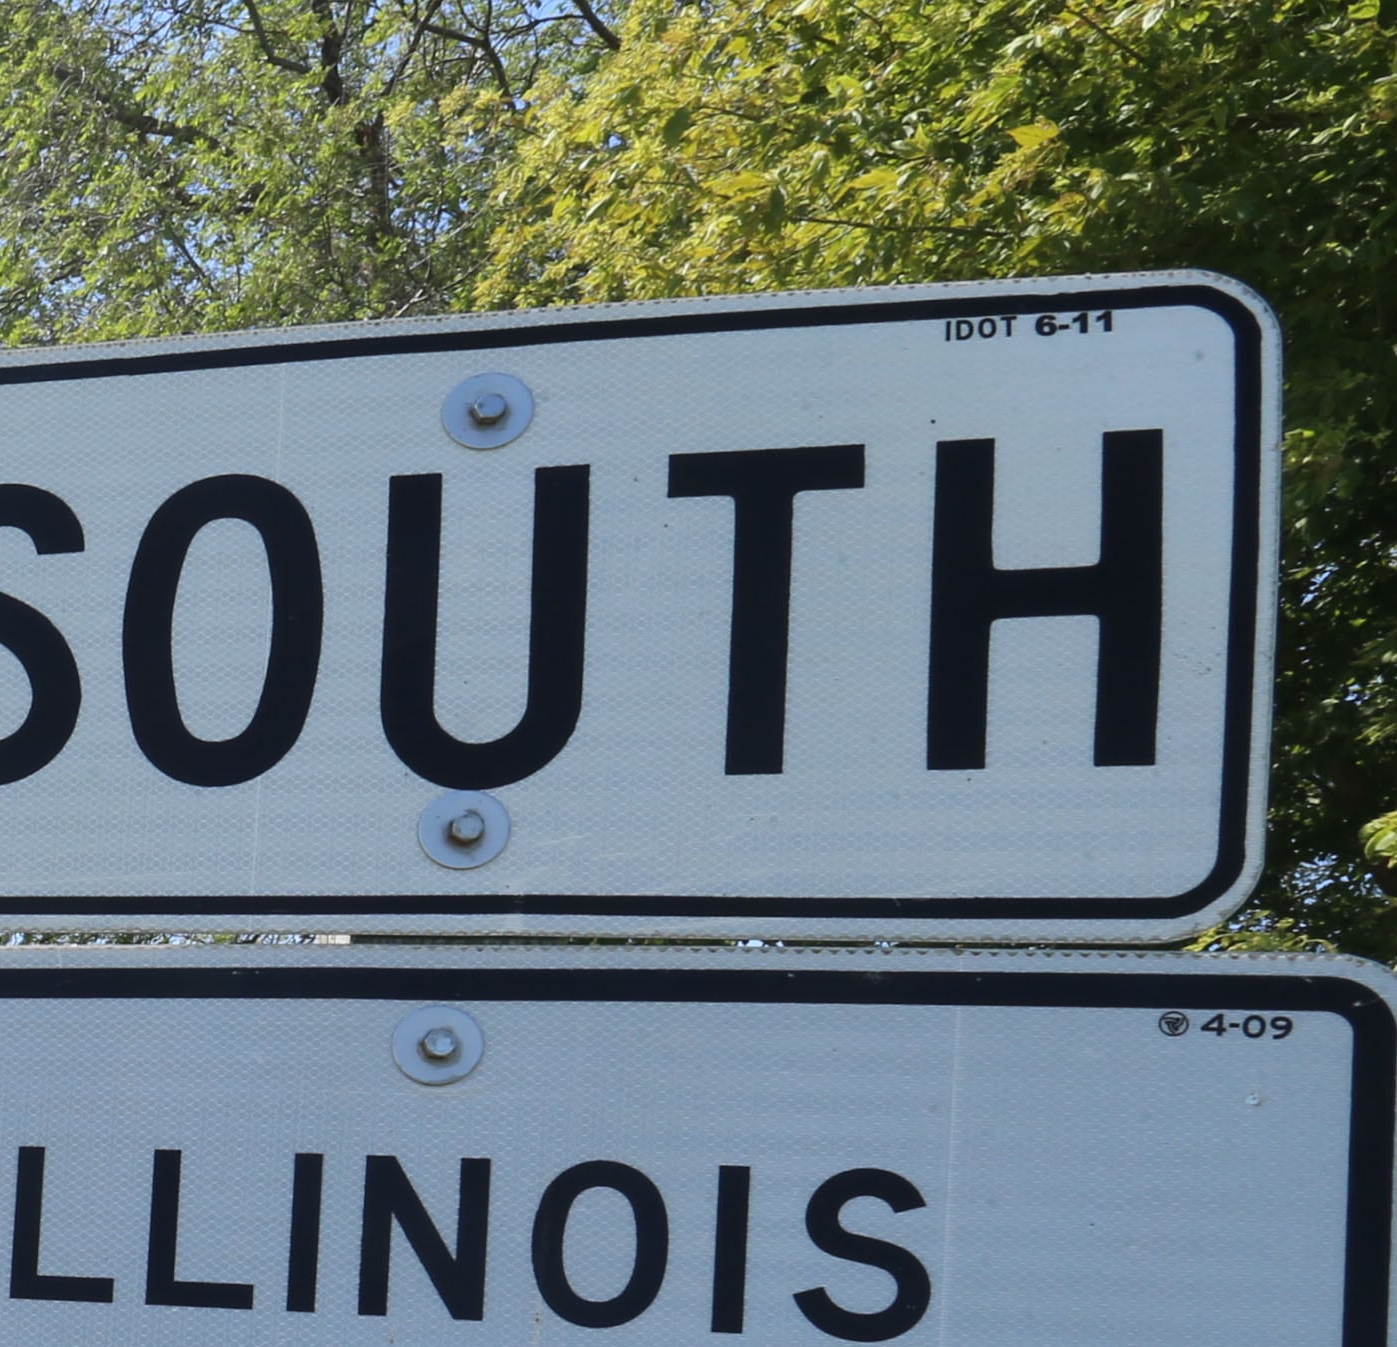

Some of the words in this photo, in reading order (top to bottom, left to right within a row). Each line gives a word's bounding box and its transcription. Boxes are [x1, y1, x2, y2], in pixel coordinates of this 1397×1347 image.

[944, 315, 1018, 342] IDOT
[1034, 310, 1115, 337] 6-11
[1199, 1012, 1294, 1040] 4-09
